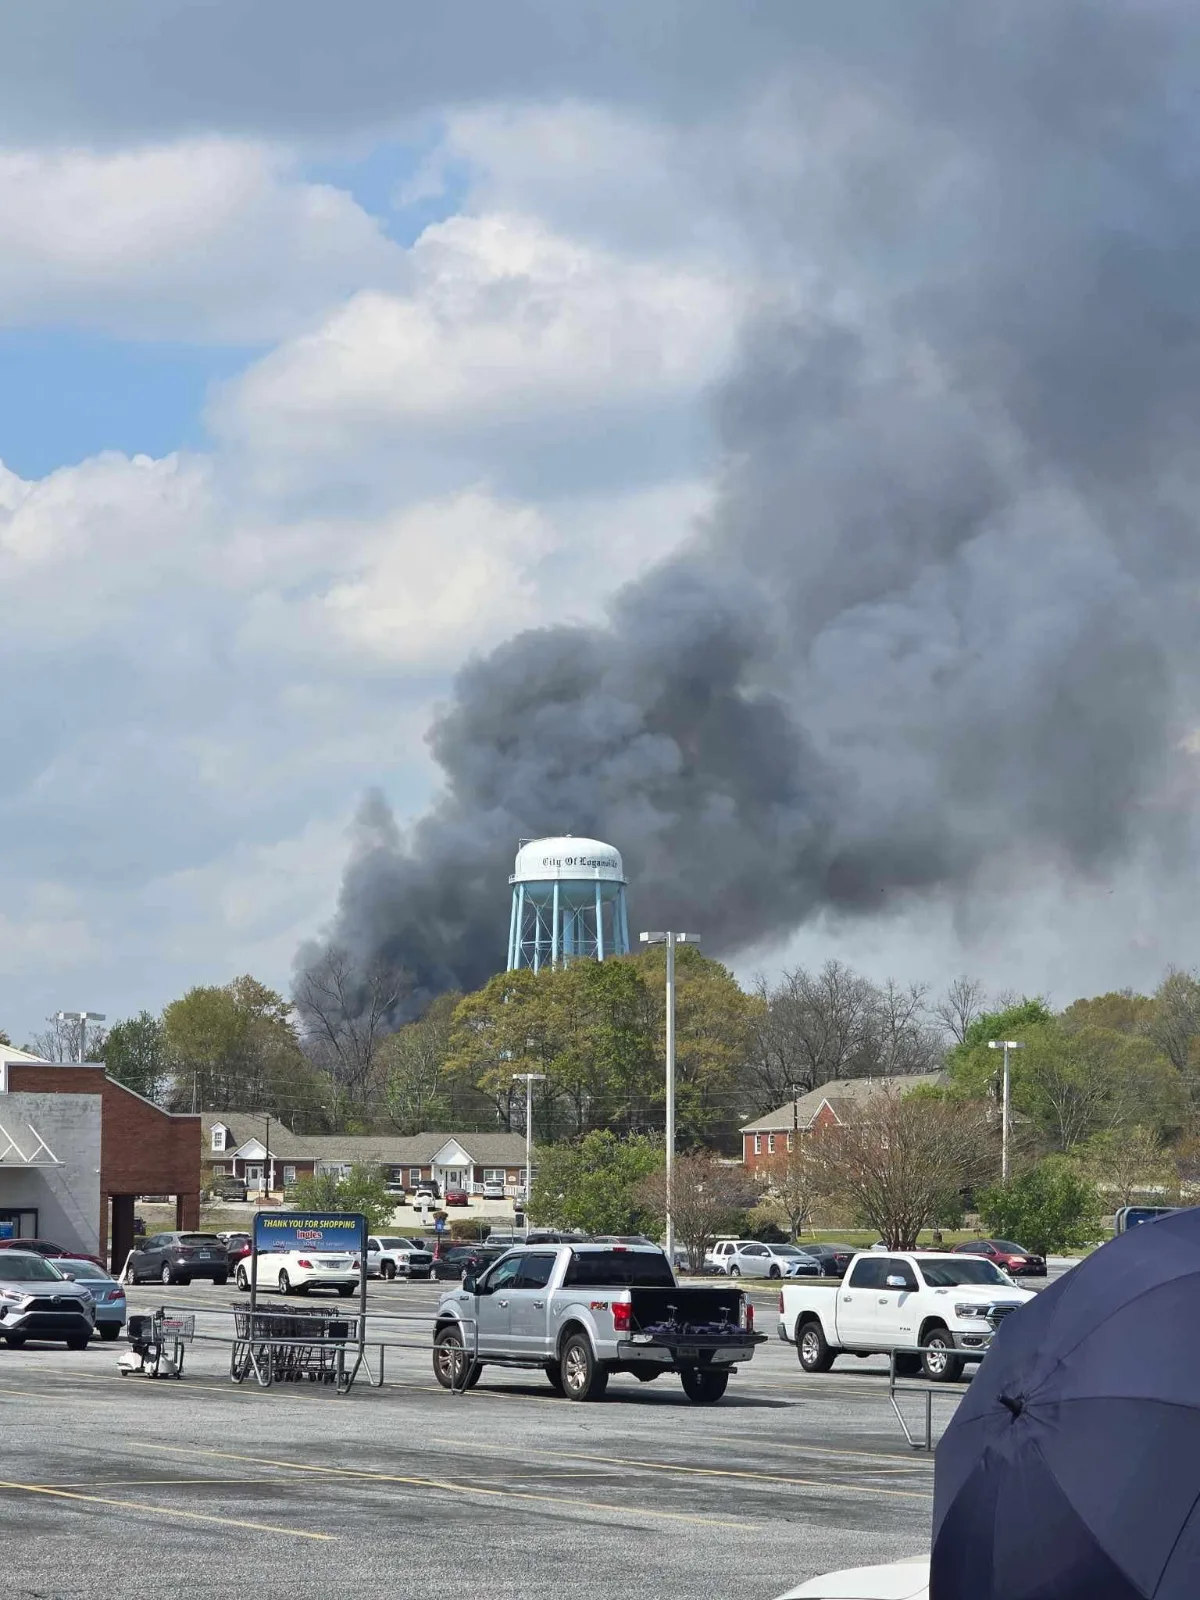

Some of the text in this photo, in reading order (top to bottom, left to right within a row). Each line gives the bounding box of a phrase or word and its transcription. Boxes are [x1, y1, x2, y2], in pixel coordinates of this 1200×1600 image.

[542, 857, 561, 867] City
[565, 857, 577, 866] Of
[264, 1220, 355, 1228] THANK YOU FOR SHOPPING
